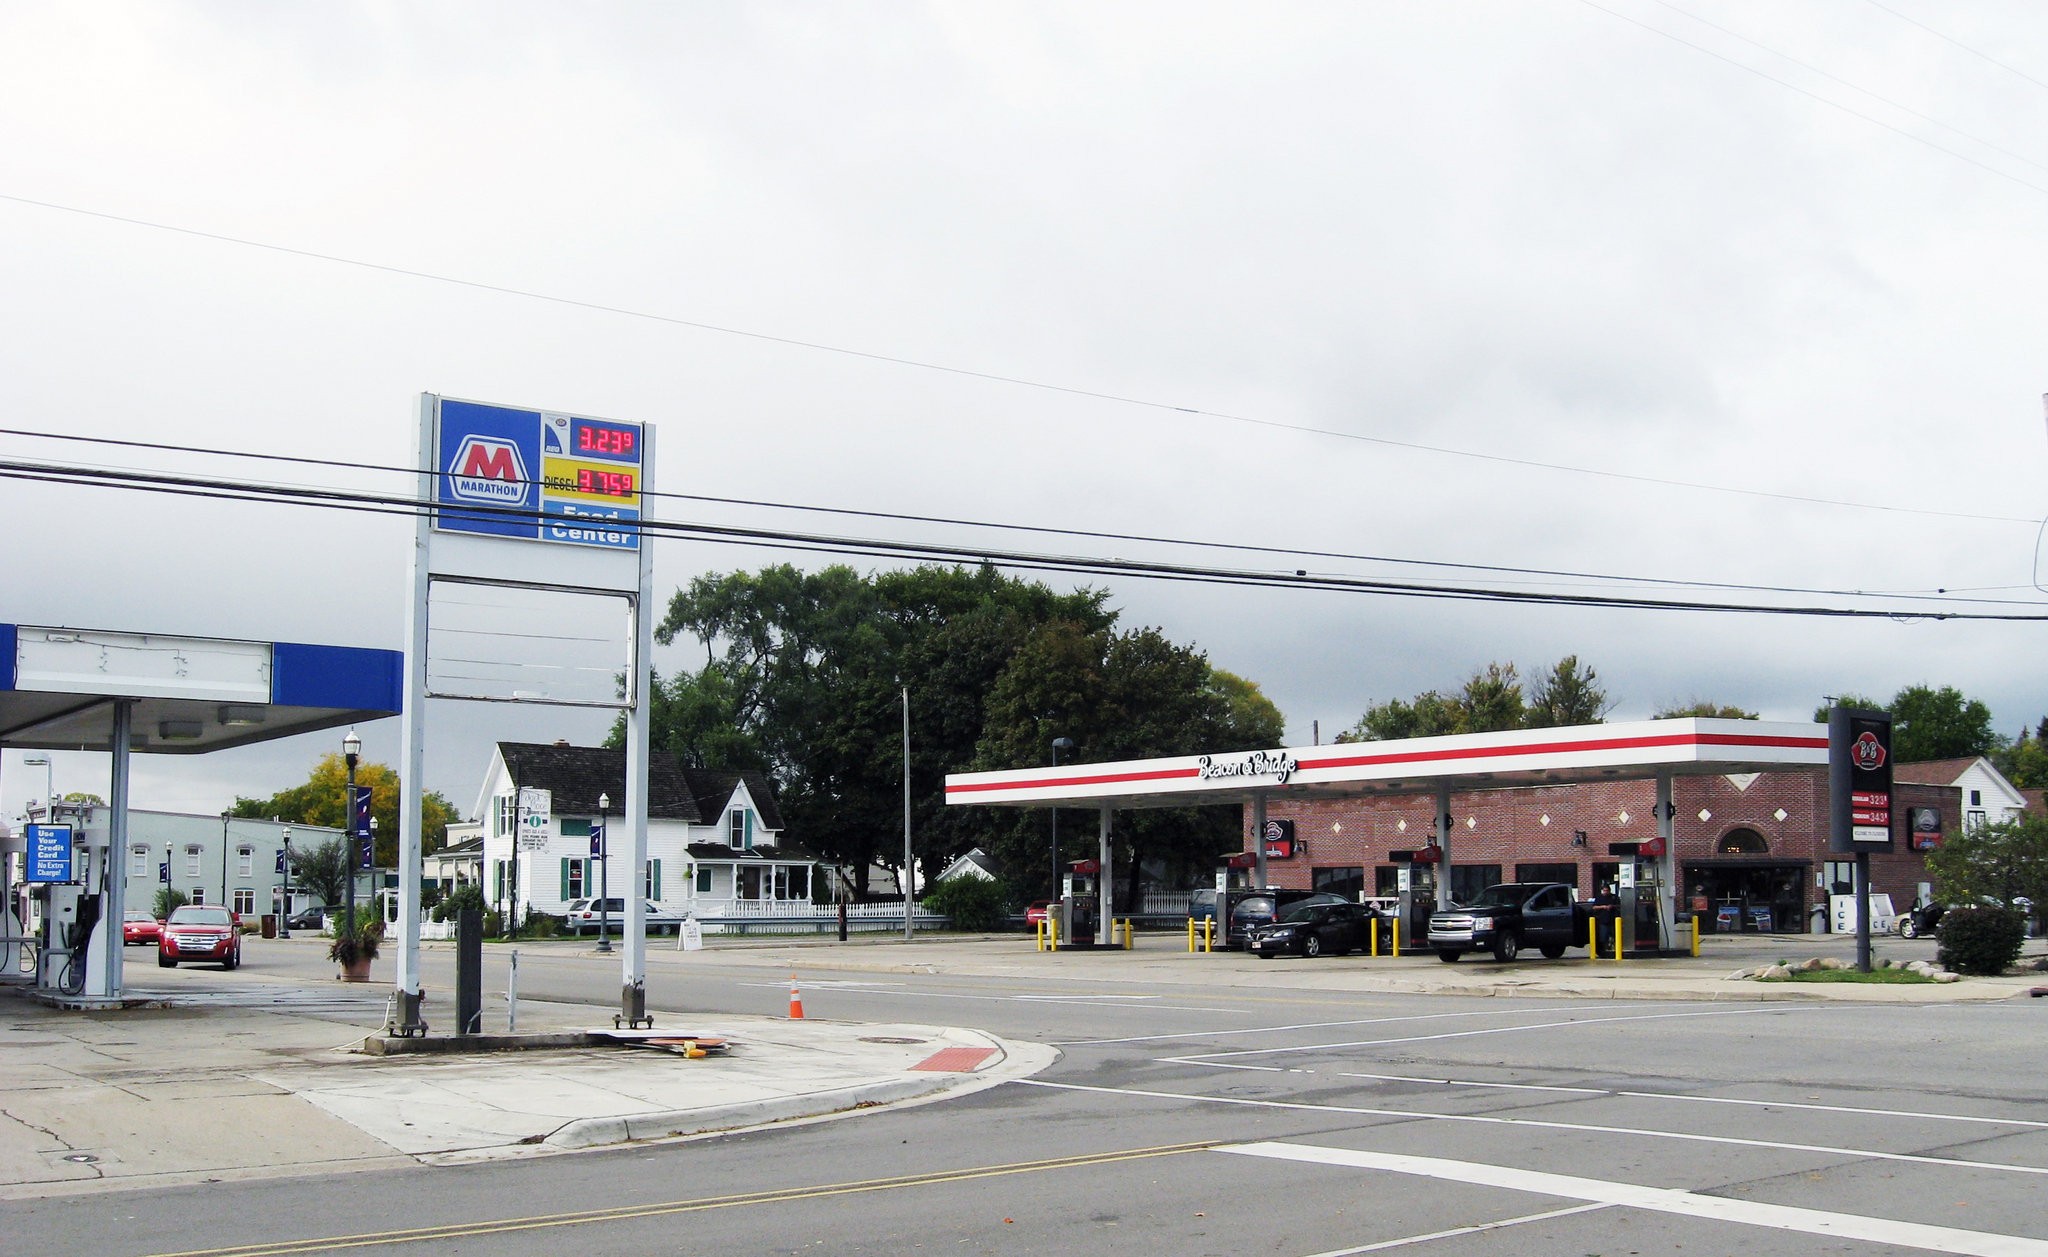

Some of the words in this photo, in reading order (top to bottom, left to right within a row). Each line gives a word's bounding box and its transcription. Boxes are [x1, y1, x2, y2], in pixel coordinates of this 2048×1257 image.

[462, 444, 518, 484] M
[460, 480, 518, 497] MARATHON
[544, 475, 578, 492] DIESEL
[551, 522, 631, 544] Center
[1198, 755, 1243, 779] Beacon
[1242, 757, 1254, 775] &
[1253, 751, 1297, 784] Bridge
